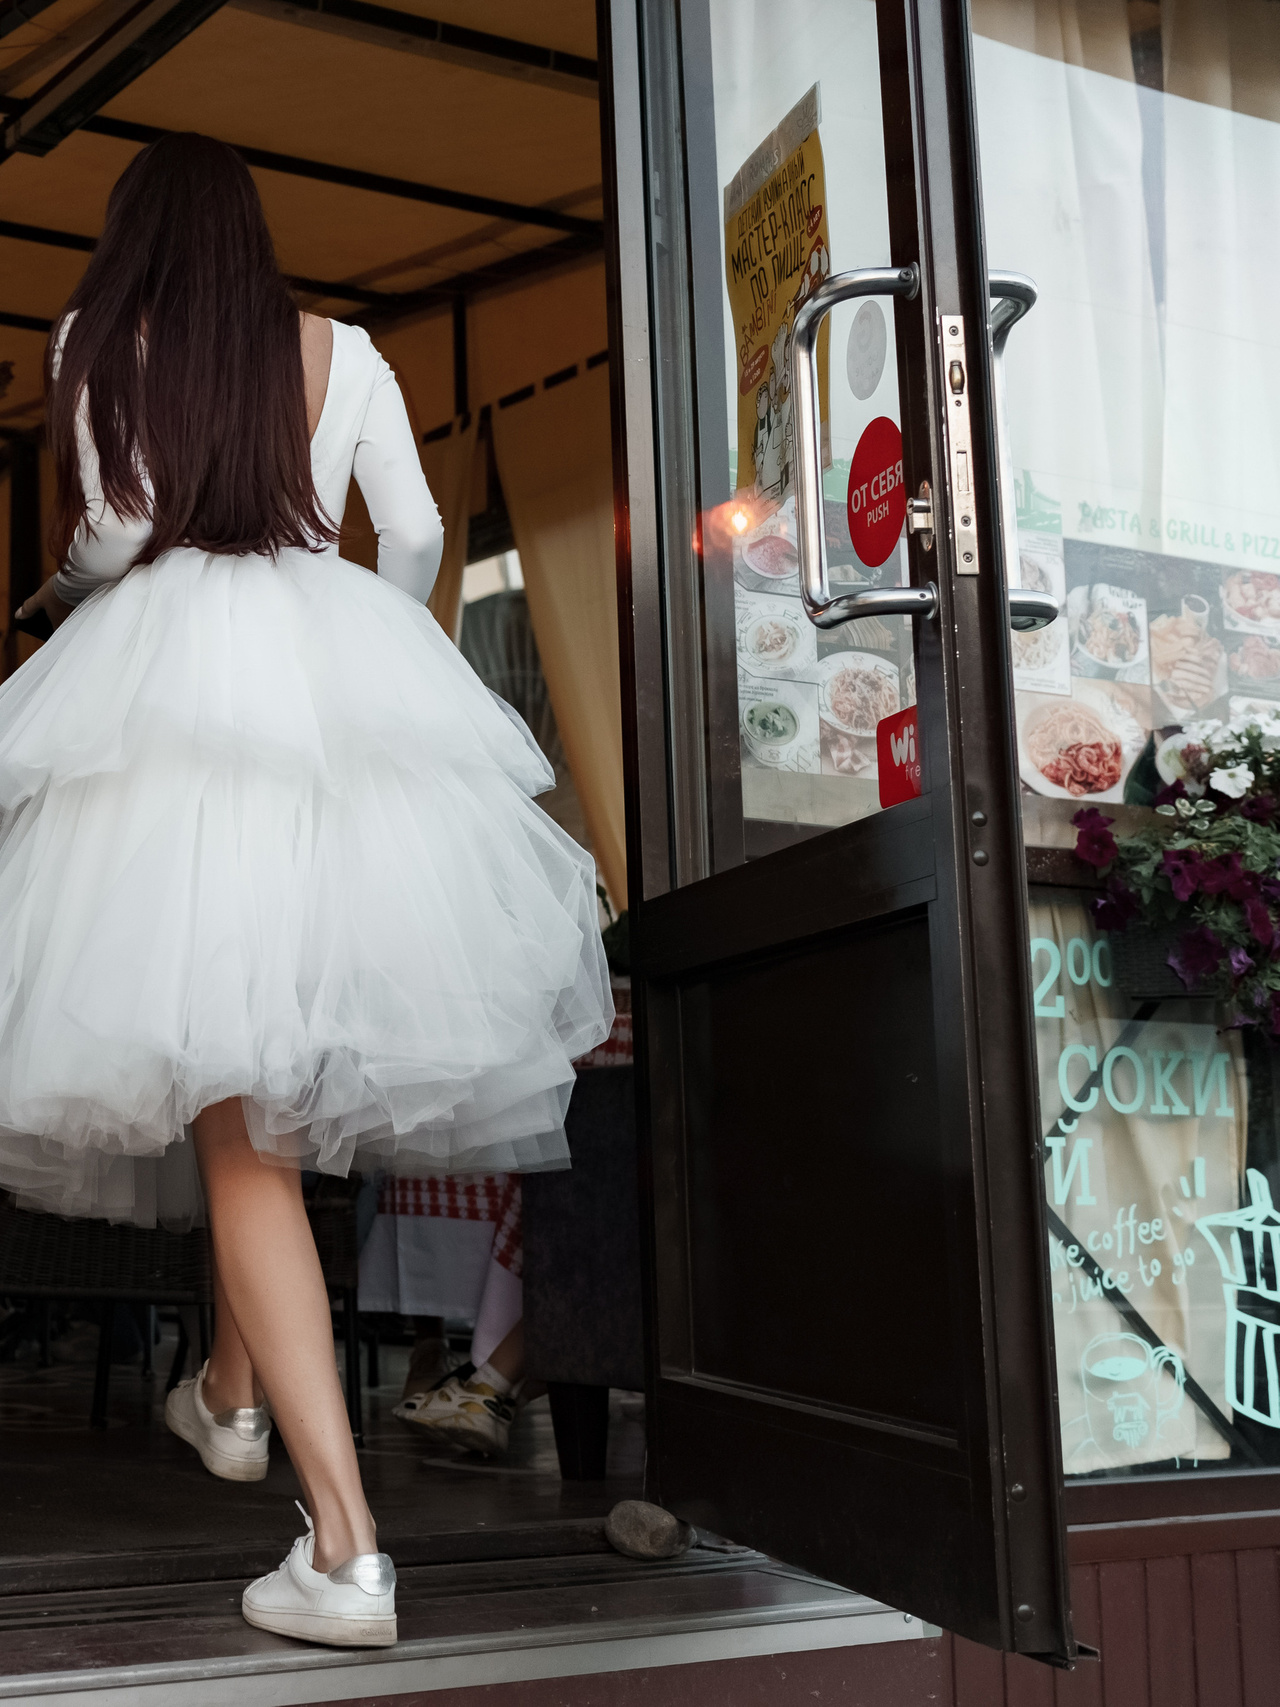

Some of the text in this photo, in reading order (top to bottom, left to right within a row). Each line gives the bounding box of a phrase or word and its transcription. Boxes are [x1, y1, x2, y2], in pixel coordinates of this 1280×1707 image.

[731, 173, 815, 284] МАСТЕР-КЛАСС
[737, 191, 763, 240] ДЕТСКИЙ
[750, 231, 806, 308] ПО ПИЦЦЕ
[851, 459, 903, 514] ОТ СЕБЯ
[867, 500, 889, 527] PUSH
[1167, 518, 1220, 549] GRILL
[1058, 1044, 1235, 1118] СОКИ
[1088, 1203, 1166, 1258] coffee
[1068, 1268, 1133, 1314] juice
[1139, 1255, 1162, 1287] to
[1172, 1247, 1195, 1285] go
